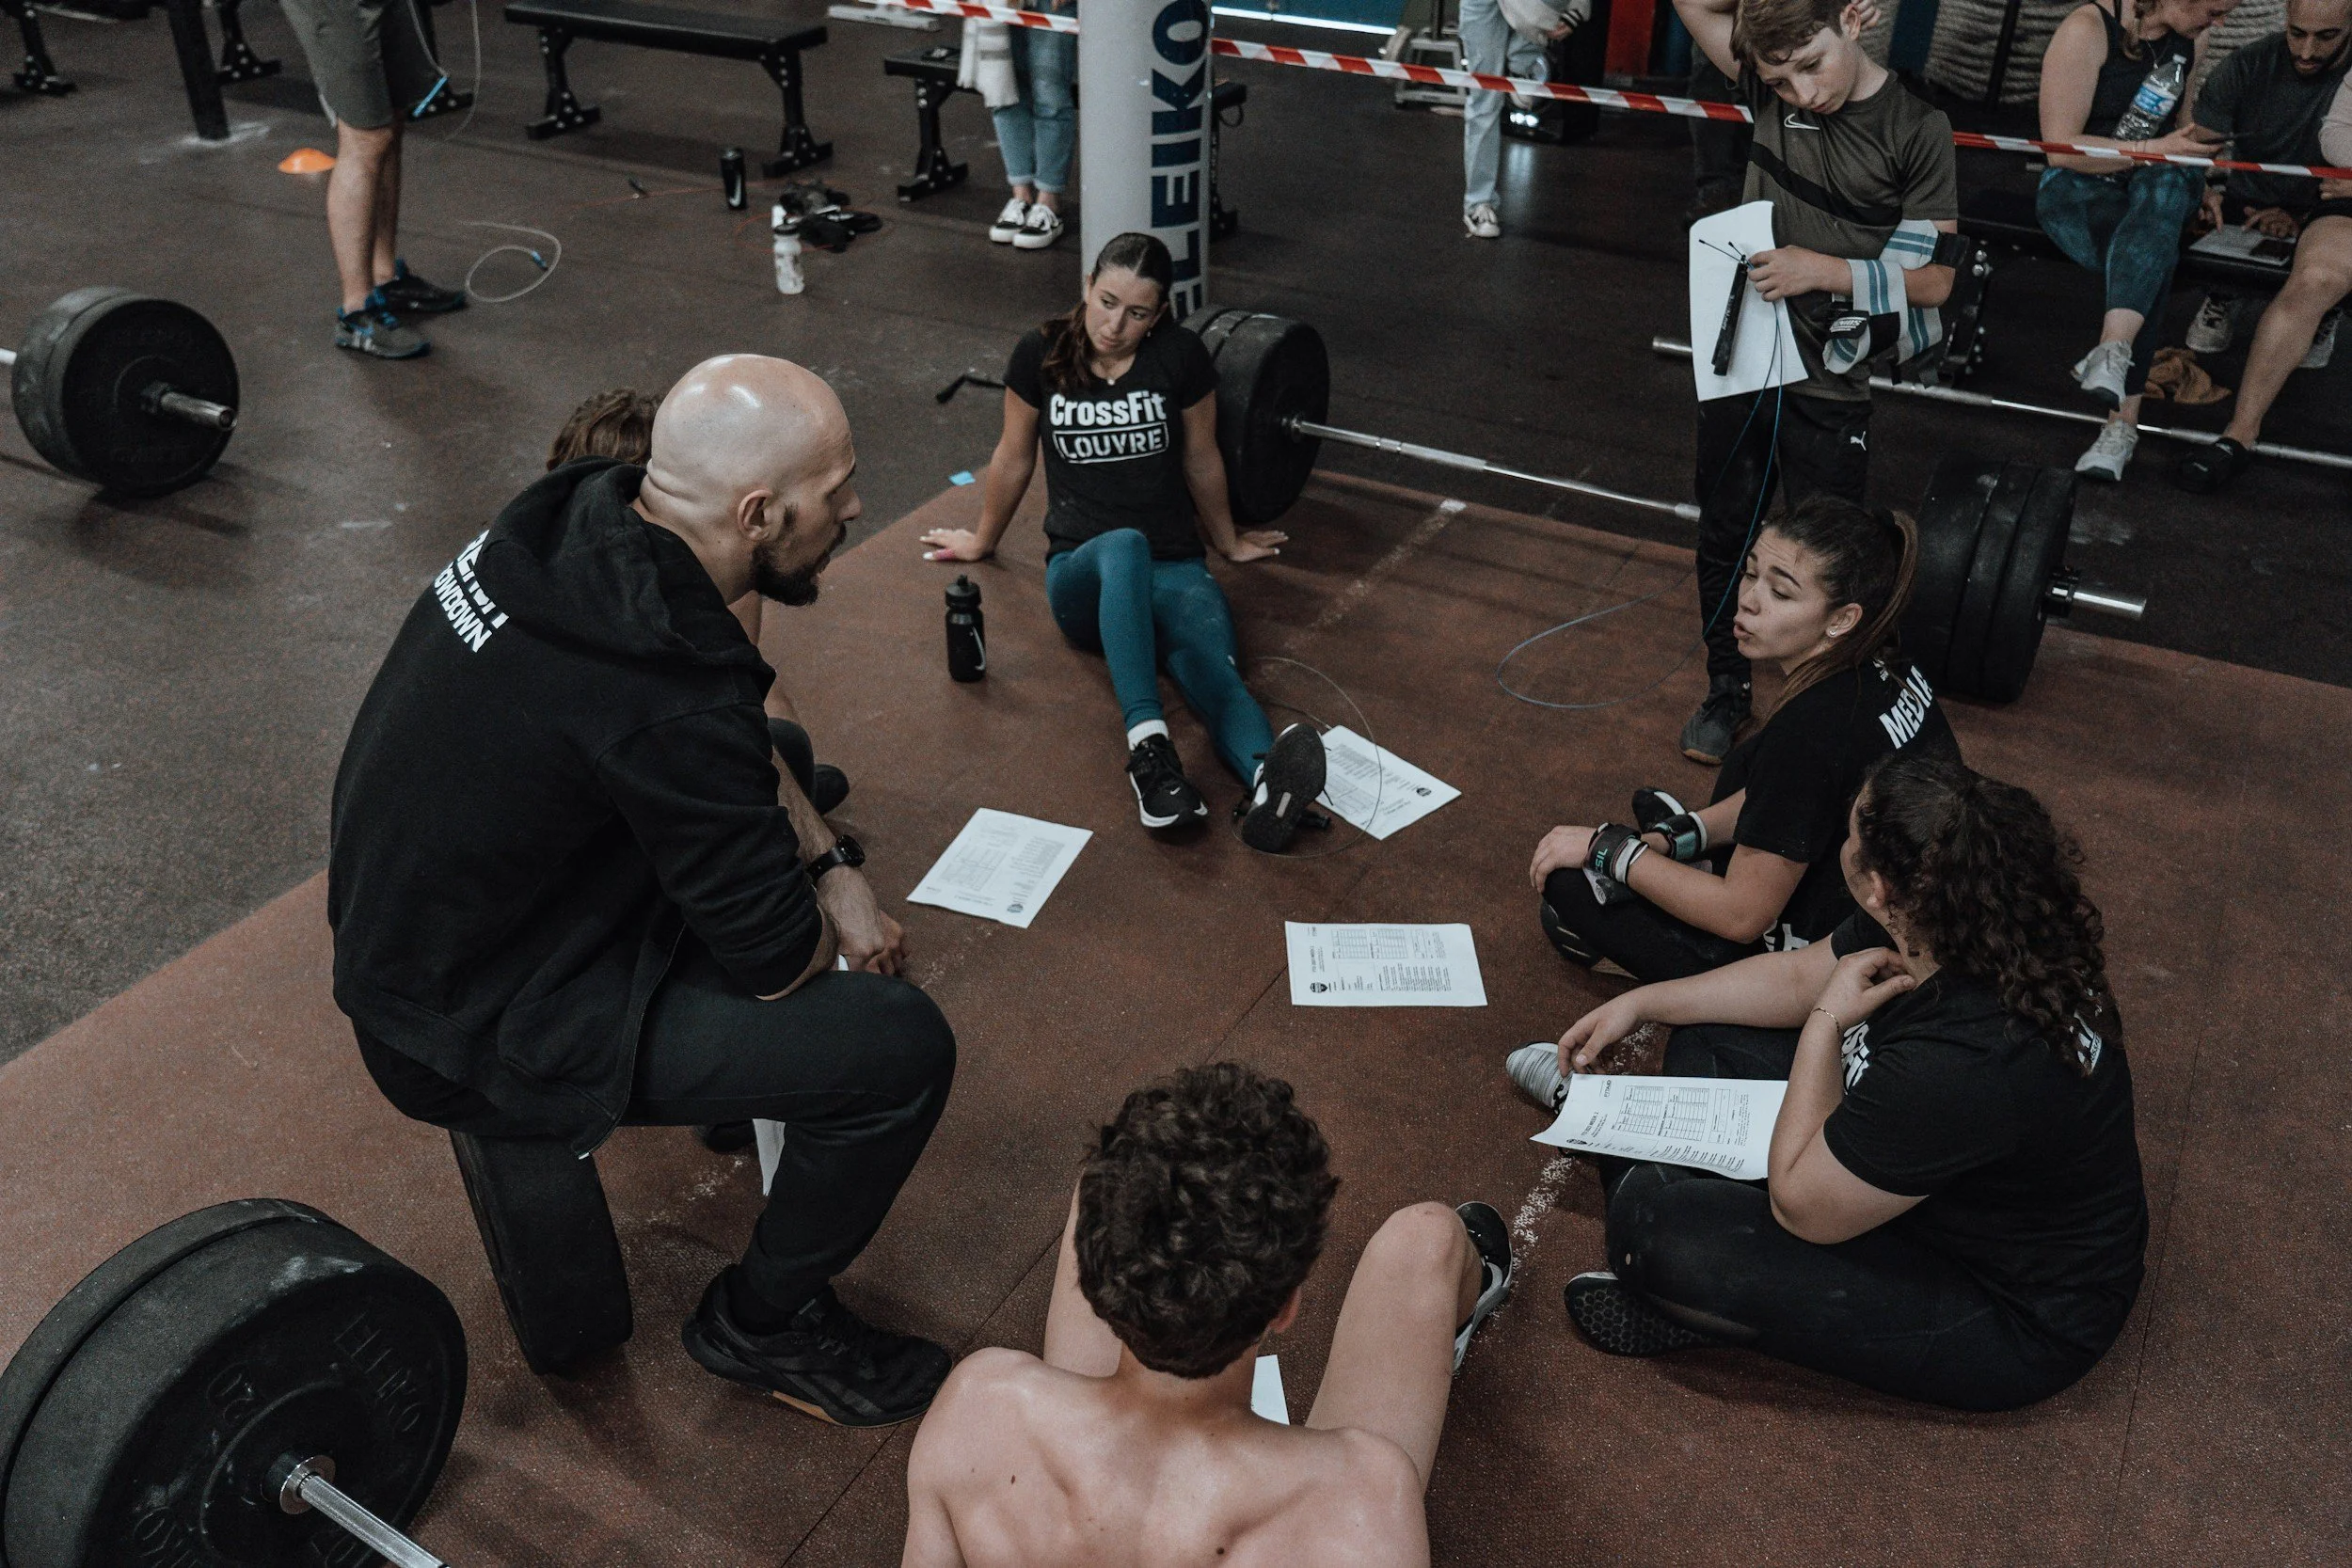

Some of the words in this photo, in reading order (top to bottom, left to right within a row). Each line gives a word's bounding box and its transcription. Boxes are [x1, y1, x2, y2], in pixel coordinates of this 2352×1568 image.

[1050, 390, 1167, 426] CrossFit
[1058, 428, 1163, 459] LOUVRE
[1878, 665, 1933, 750] MEDIA
